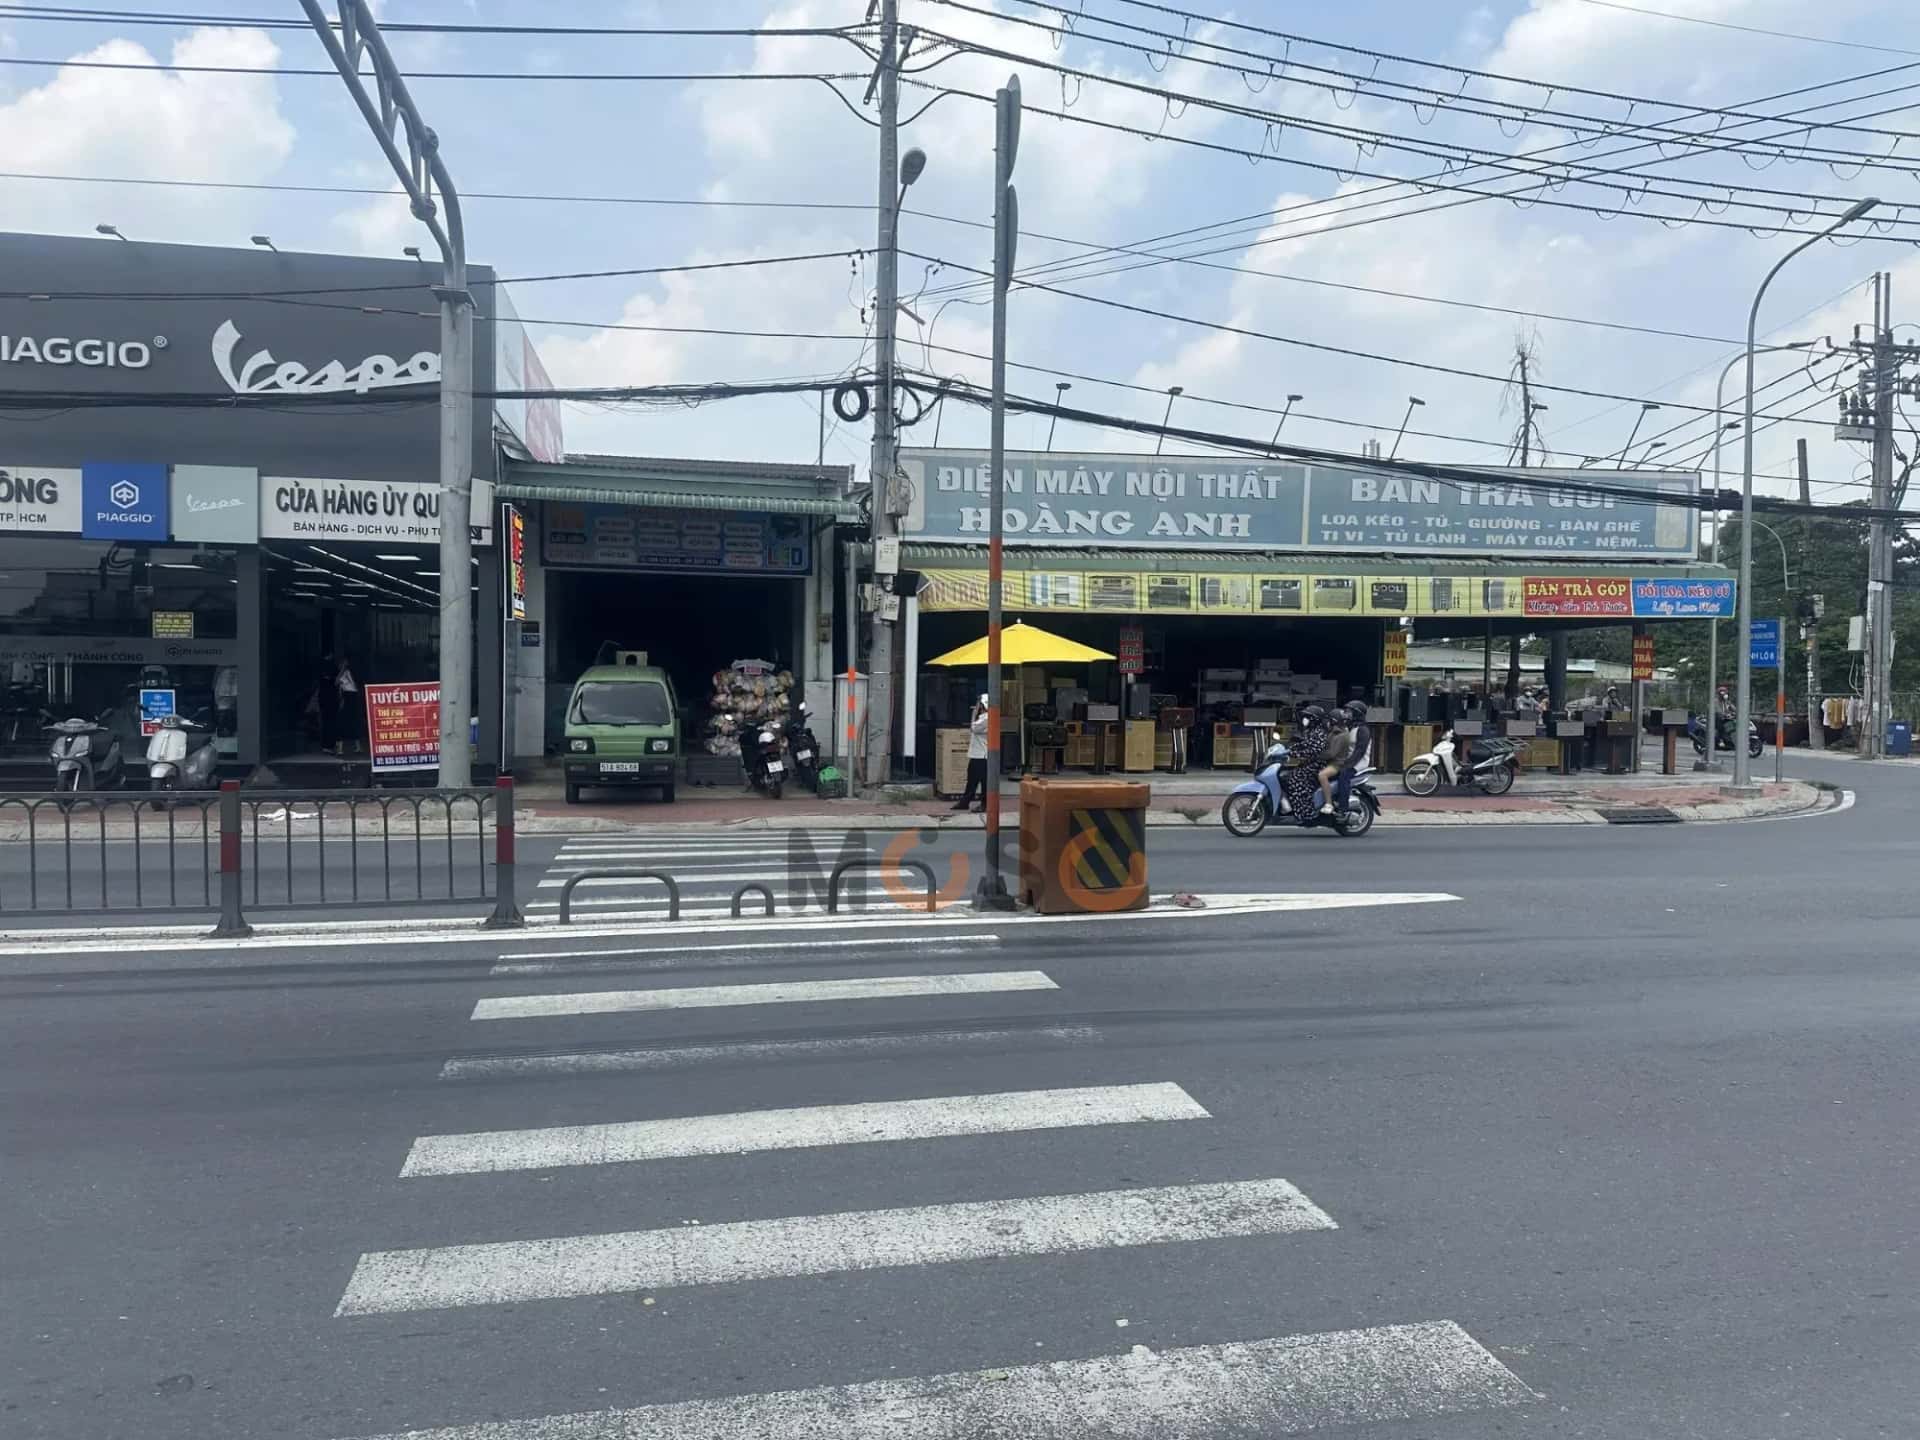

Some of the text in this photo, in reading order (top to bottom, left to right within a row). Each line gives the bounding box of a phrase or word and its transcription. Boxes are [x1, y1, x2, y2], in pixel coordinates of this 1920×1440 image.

[936, 463, 1282, 502] ĐIỆN MÁY NỘI THẤT
[187, 493, 246, 512] Vespa
[275, 481, 319, 514] CỬA
[322, 483, 378, 516] HÀNG
[382, 485, 409, 517] ỦY
[19, 513, 47, 523] HCM
[97, 512, 152, 523] PIAGGIO
[958, 502, 1252, 537] HOÀNG ANH
[1321, 514, 1359, 526] LOA
[1365, 513, 1404, 527] KÉO
[1424, 514, 1449, 528] TỦ
[1468, 516, 1541, 530] GIƯỜNG
[1604, 519, 1641, 533] GHẾ
[357, 525, 382, 536] DỊCH
[385, 526, 399, 536] VỤ
[408, 527, 429, 537] PHỤ
[1320, 531, 1338, 541] TI
[1344, 531, 1364, 542] VI
[1384, 529, 1408, 543] TỦ
[1414, 532, 1466, 545] LẠNH
[1486, 533, 1528, 546] MÁY
[1534, 534, 1577, 548] GIẶT
[1528, 579, 1627, 596] BÁN TRẢ GÓP
[1660, 585, 1686, 598] LOA
